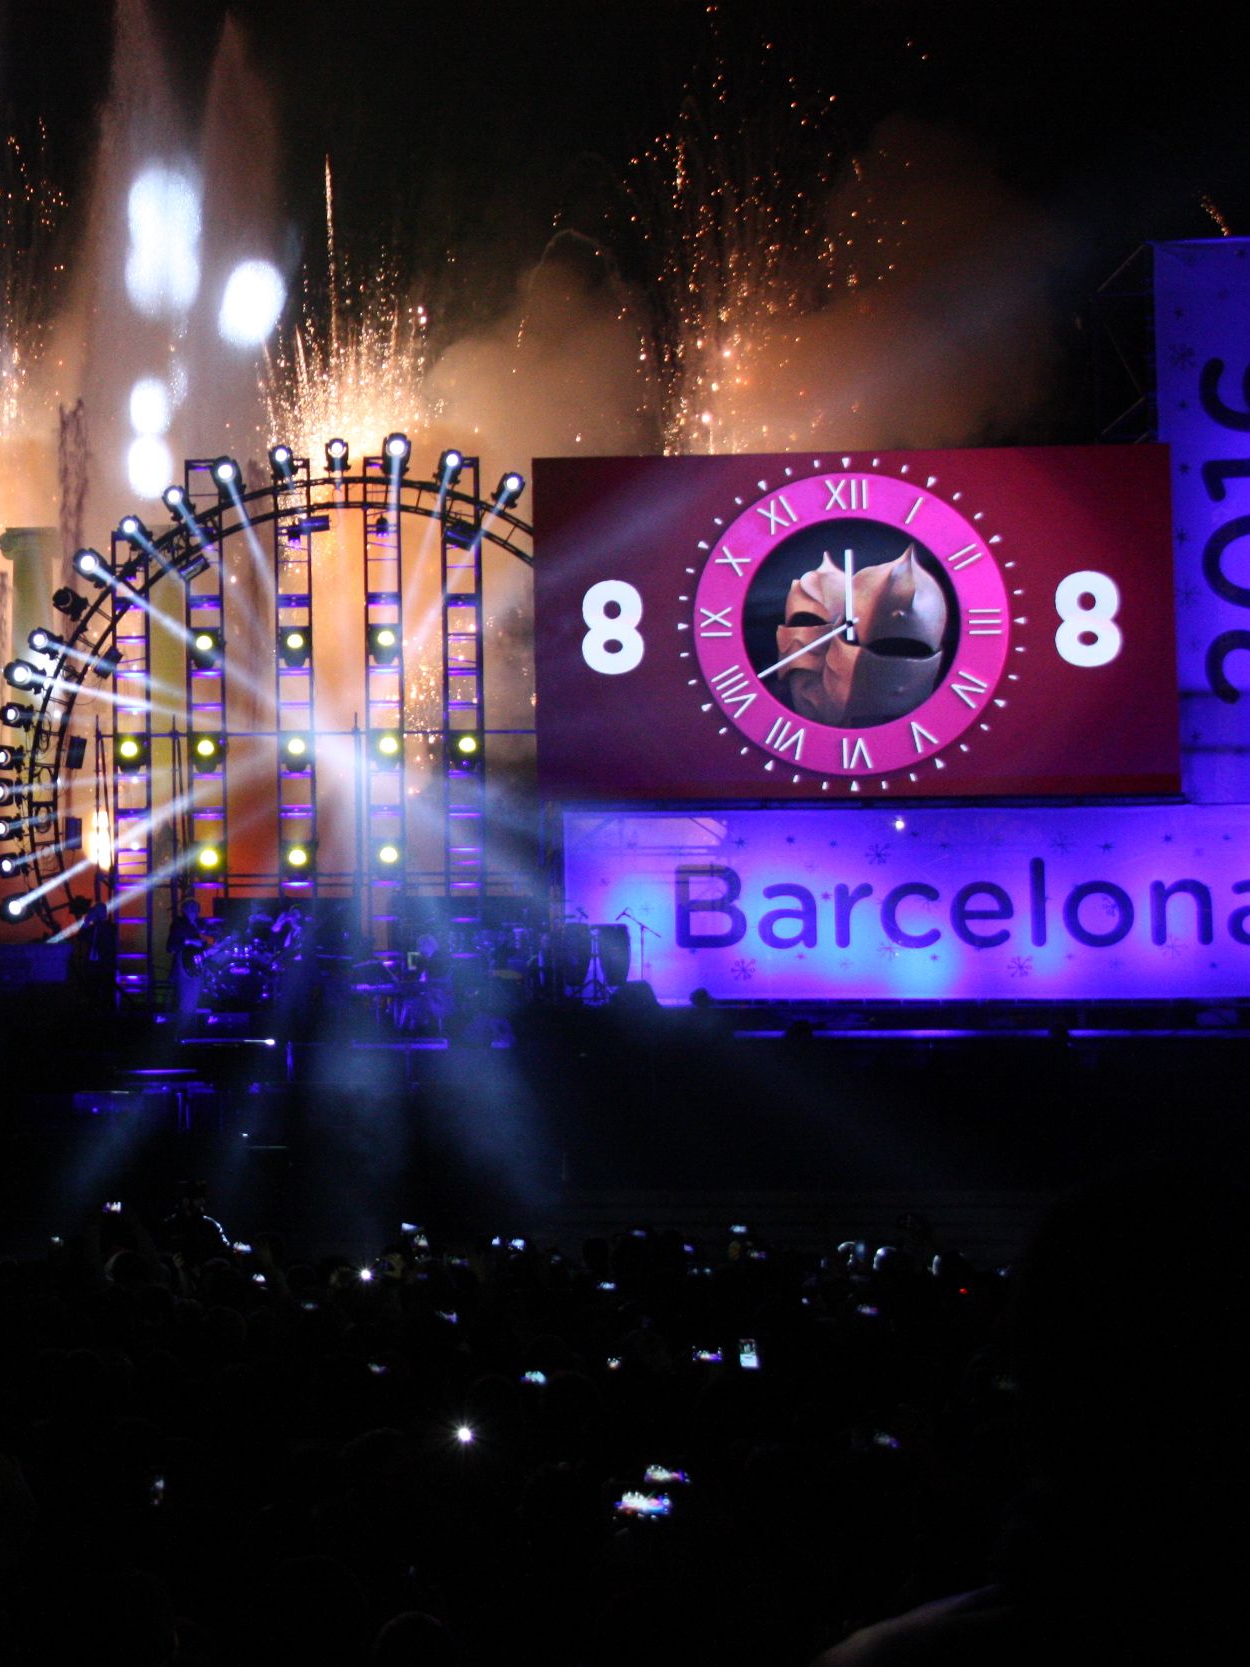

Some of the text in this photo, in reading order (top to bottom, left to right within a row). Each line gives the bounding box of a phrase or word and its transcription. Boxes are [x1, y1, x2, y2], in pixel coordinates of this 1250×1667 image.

[825, 479, 868, 511] XII
[756, 495, 798, 535] XI
[715, 545, 751, 577] X
[948, 543, 982, 571] II
[581, 579, 644, 675] 8
[700, 606, 733, 637] IX
[968, 608, 1002, 635] III
[1055, 570, 1121, 668] 8
[711, 664, 758, 719] VIII
[950, 670, 988, 709] IV
[765, 716, 805, 761] VII
[842, 737, 873, 769] VI
[910, 721, 939, 754] V
